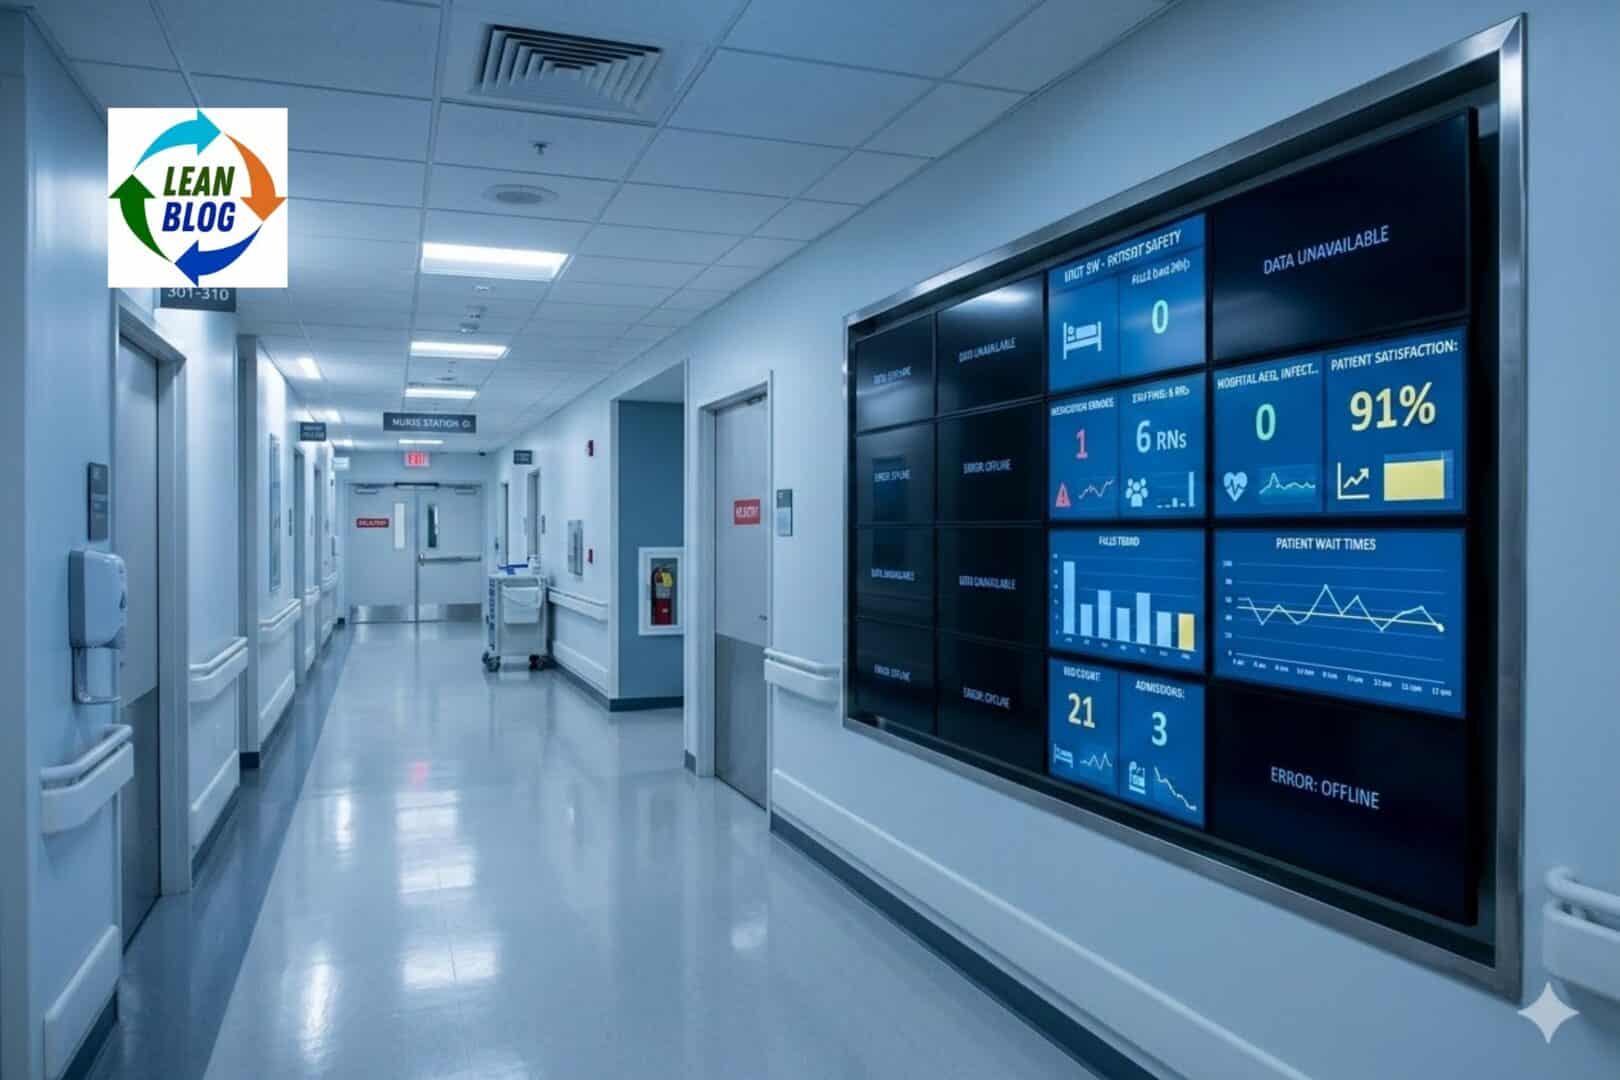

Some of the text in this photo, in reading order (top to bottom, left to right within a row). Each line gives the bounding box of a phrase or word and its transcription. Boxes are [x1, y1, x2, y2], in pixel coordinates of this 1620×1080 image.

[1145, 229, 1182, 254] SAFETY
[1263, 225, 1389, 274] DATA UNAVAILABLE
[167, 288, 229, 301] 301-310
[1152, 299, 1169, 334] 0
[1330, 339, 1458, 372] PATIENT SATISFACTION:
[1255, 403, 1276, 441] 0
[1350, 382, 1436, 431] 91%
[1076, 429, 1088, 459] 1
[1136, 420, 1187, 452] 6 RNs
[1276, 537, 1376, 551] PATIENT WAIT TIMES
[1068, 692, 1095, 728] 21
[1152, 711, 1168, 746] 3
[1271, 766, 1380, 810] ERROR: OFFLINE
